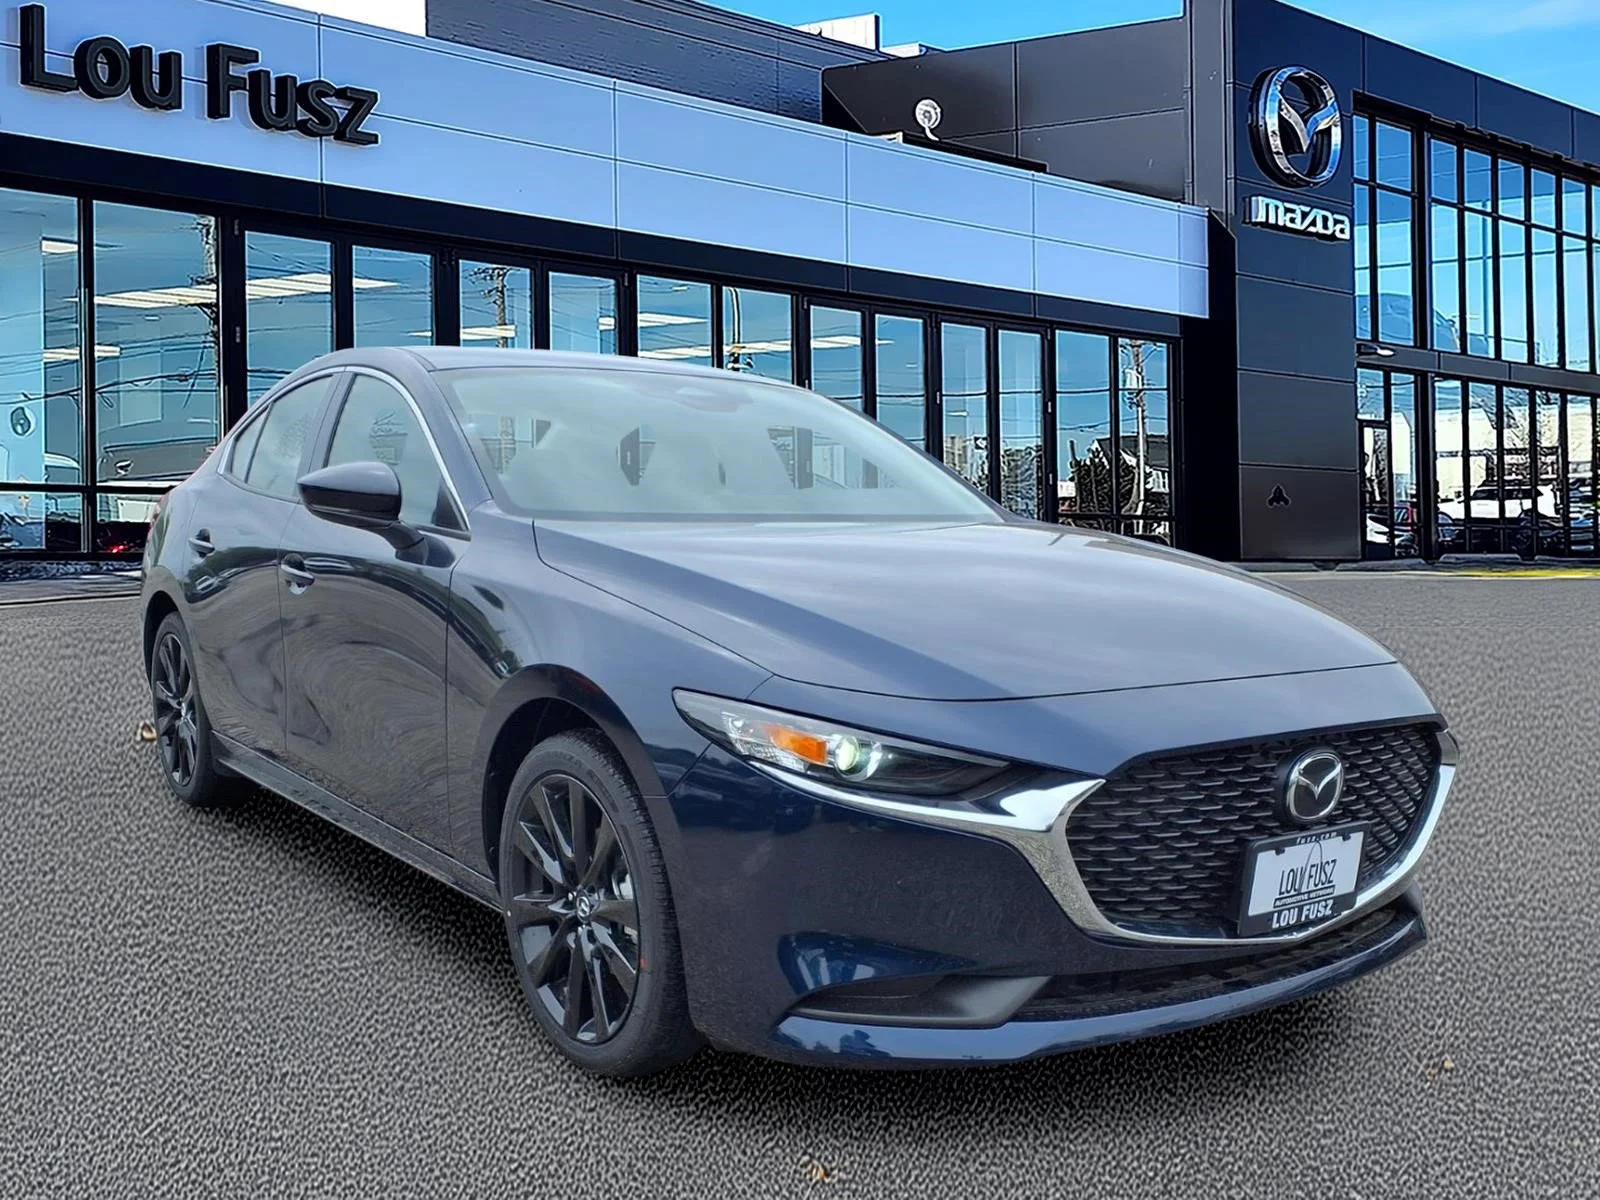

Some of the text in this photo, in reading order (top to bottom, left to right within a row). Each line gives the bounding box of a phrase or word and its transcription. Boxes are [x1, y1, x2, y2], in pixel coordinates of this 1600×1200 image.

[19, 3, 380, 146] Lou Fusz
[1248, 196, 1351, 240] mazda
[1278, 858, 1338, 896] LOU FUSZ
[1272, 899, 1334, 929] LOU FUSZ
